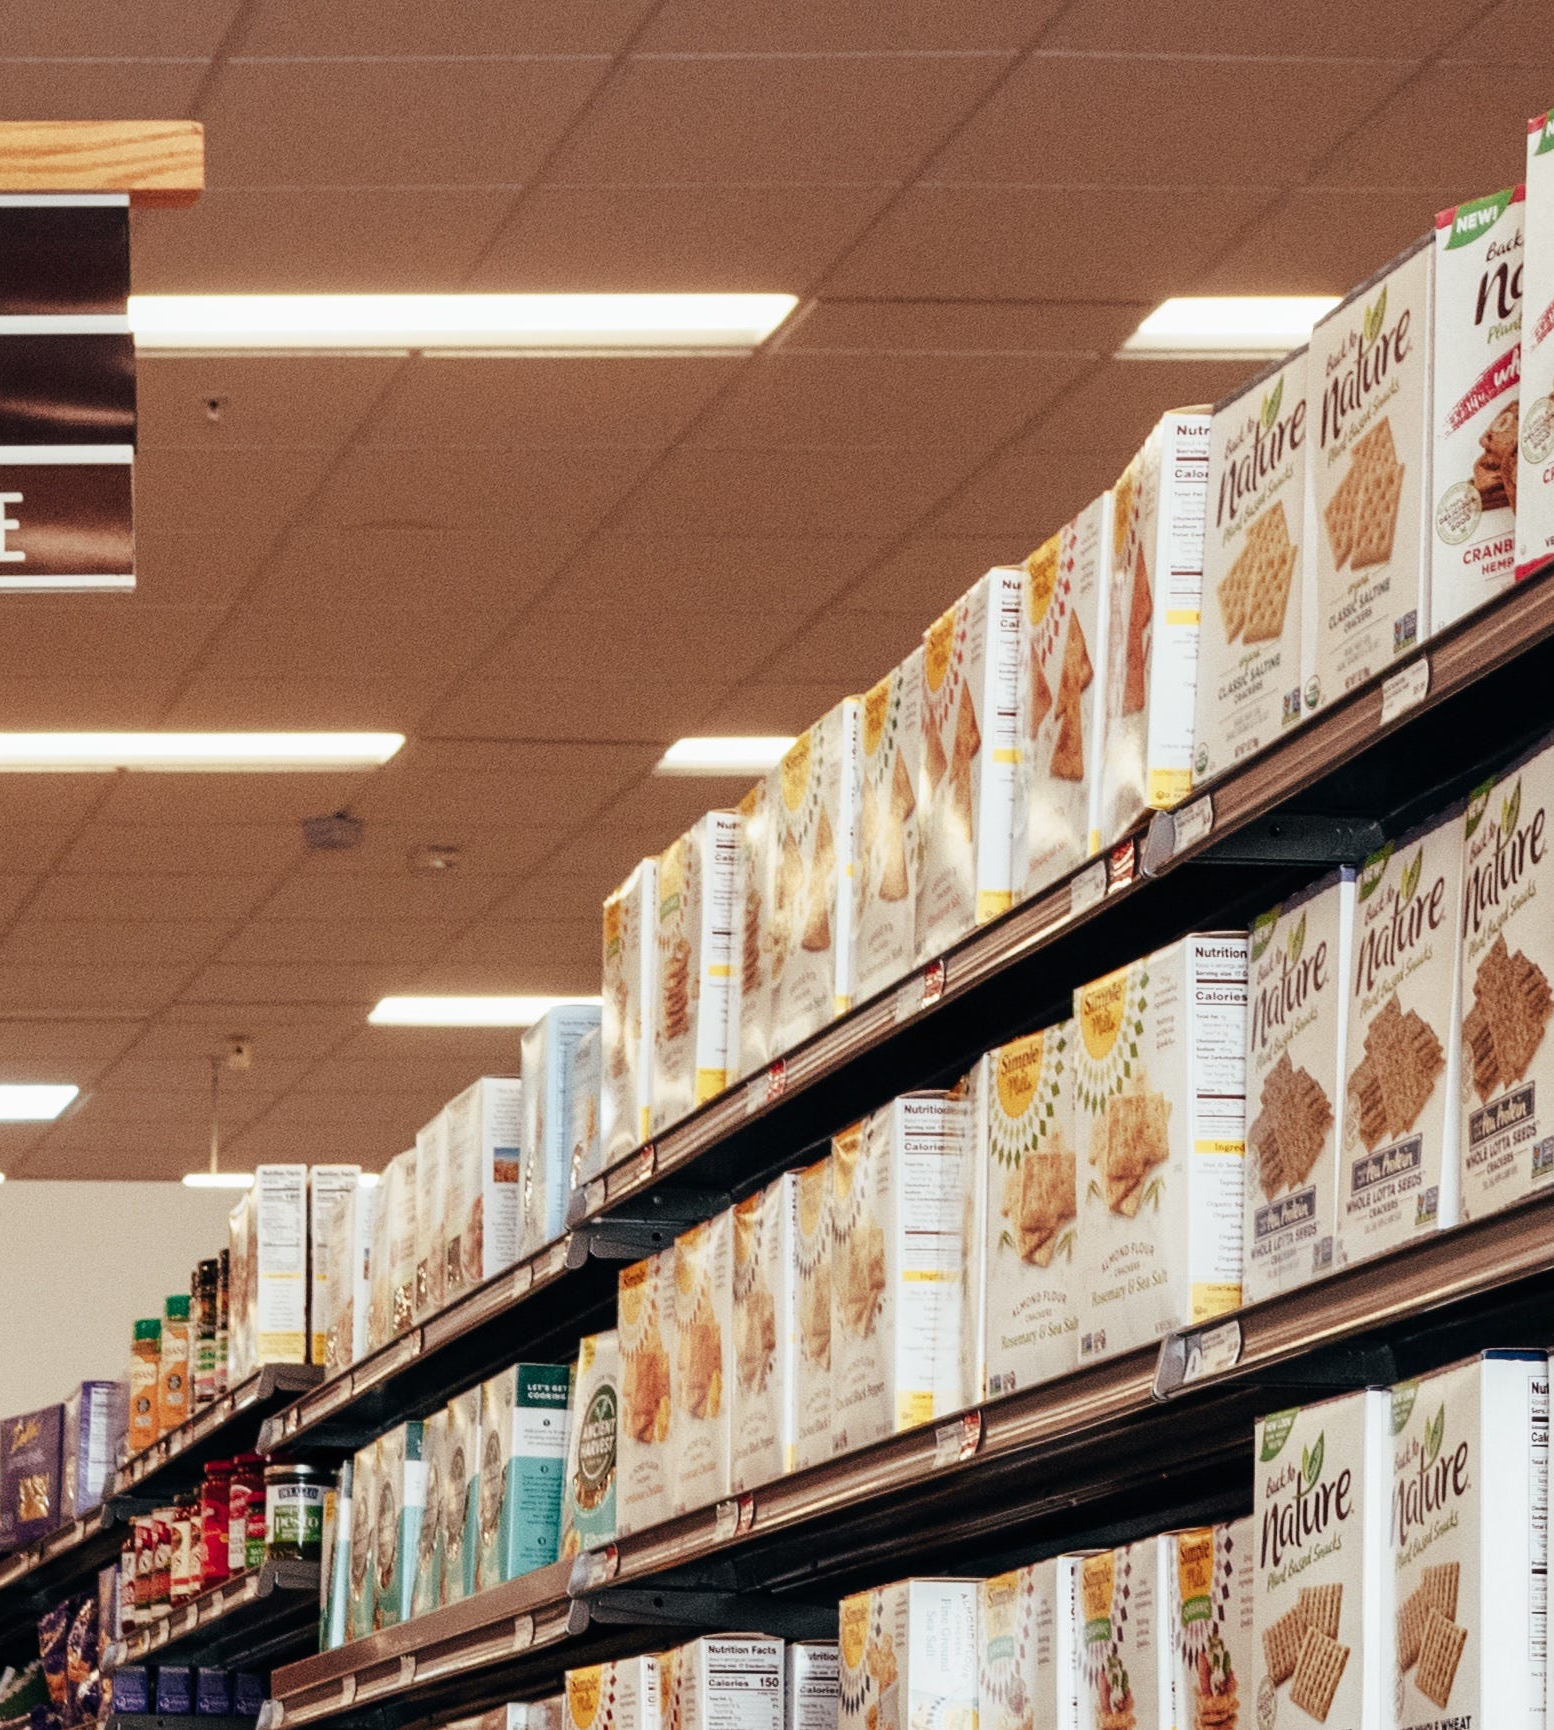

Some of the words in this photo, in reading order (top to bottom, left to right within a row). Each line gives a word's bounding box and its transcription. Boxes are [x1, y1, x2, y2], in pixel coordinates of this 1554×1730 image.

[1456, 205, 1500, 233] NEW!
[1319, 308, 1414, 448] nature
[1216, 397, 1307, 528] nature
[1463, 807, 1548, 940] nature
[1195, 945, 1248, 961] Nutrition
[1356, 876, 1446, 998] nature
[1250, 939, 1329, 1052] nature
[1001, 1050, 1040, 1075] Simple
[1260, 1468, 1354, 1570] nature
[708, 1645, 748, 1656] Nutrition
[750, 1644, 777, 1656] Facts
[708, 1678, 750, 1691] Calories
[759, 1676, 780, 1688] 150
